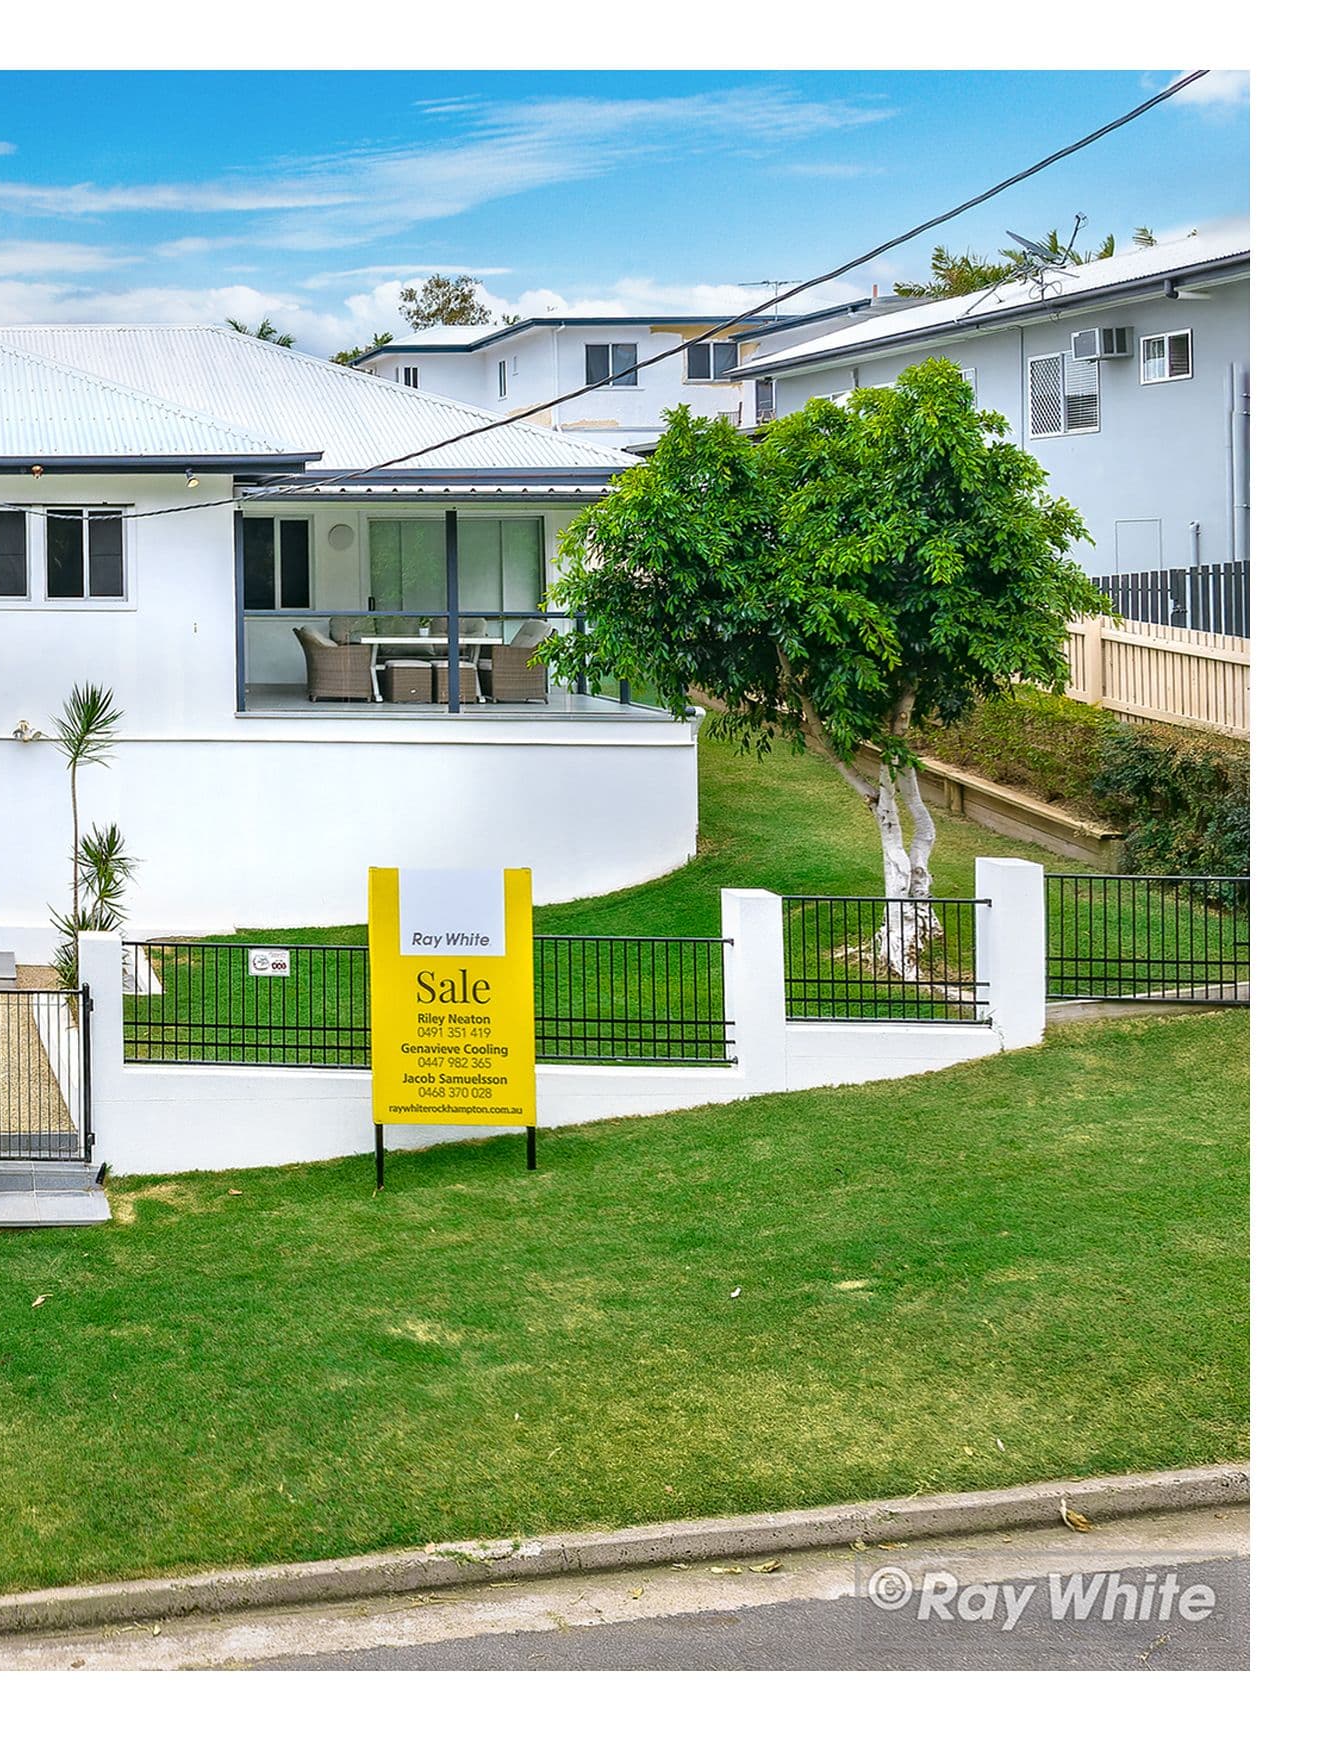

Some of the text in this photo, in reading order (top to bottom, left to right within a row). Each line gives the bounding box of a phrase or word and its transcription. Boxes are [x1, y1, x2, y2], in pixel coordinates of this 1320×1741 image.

[412, 932, 490, 948] Ray White
[416, 969, 491, 1004] Sale
[417, 1013, 491, 1026] Riley Neaton
[417, 1027, 491, 1038] 0491 351 419
[401, 1043, 509, 1057] Genavieve Cooling
[417, 1057, 492, 1069] 0447 982 365
[402, 1073, 508, 1085] Jacob Samuelsson
[418, 1087, 492, 1099] 0468 370 028
[389, 1104, 523, 1115] raywhiterockhampton.com.au
